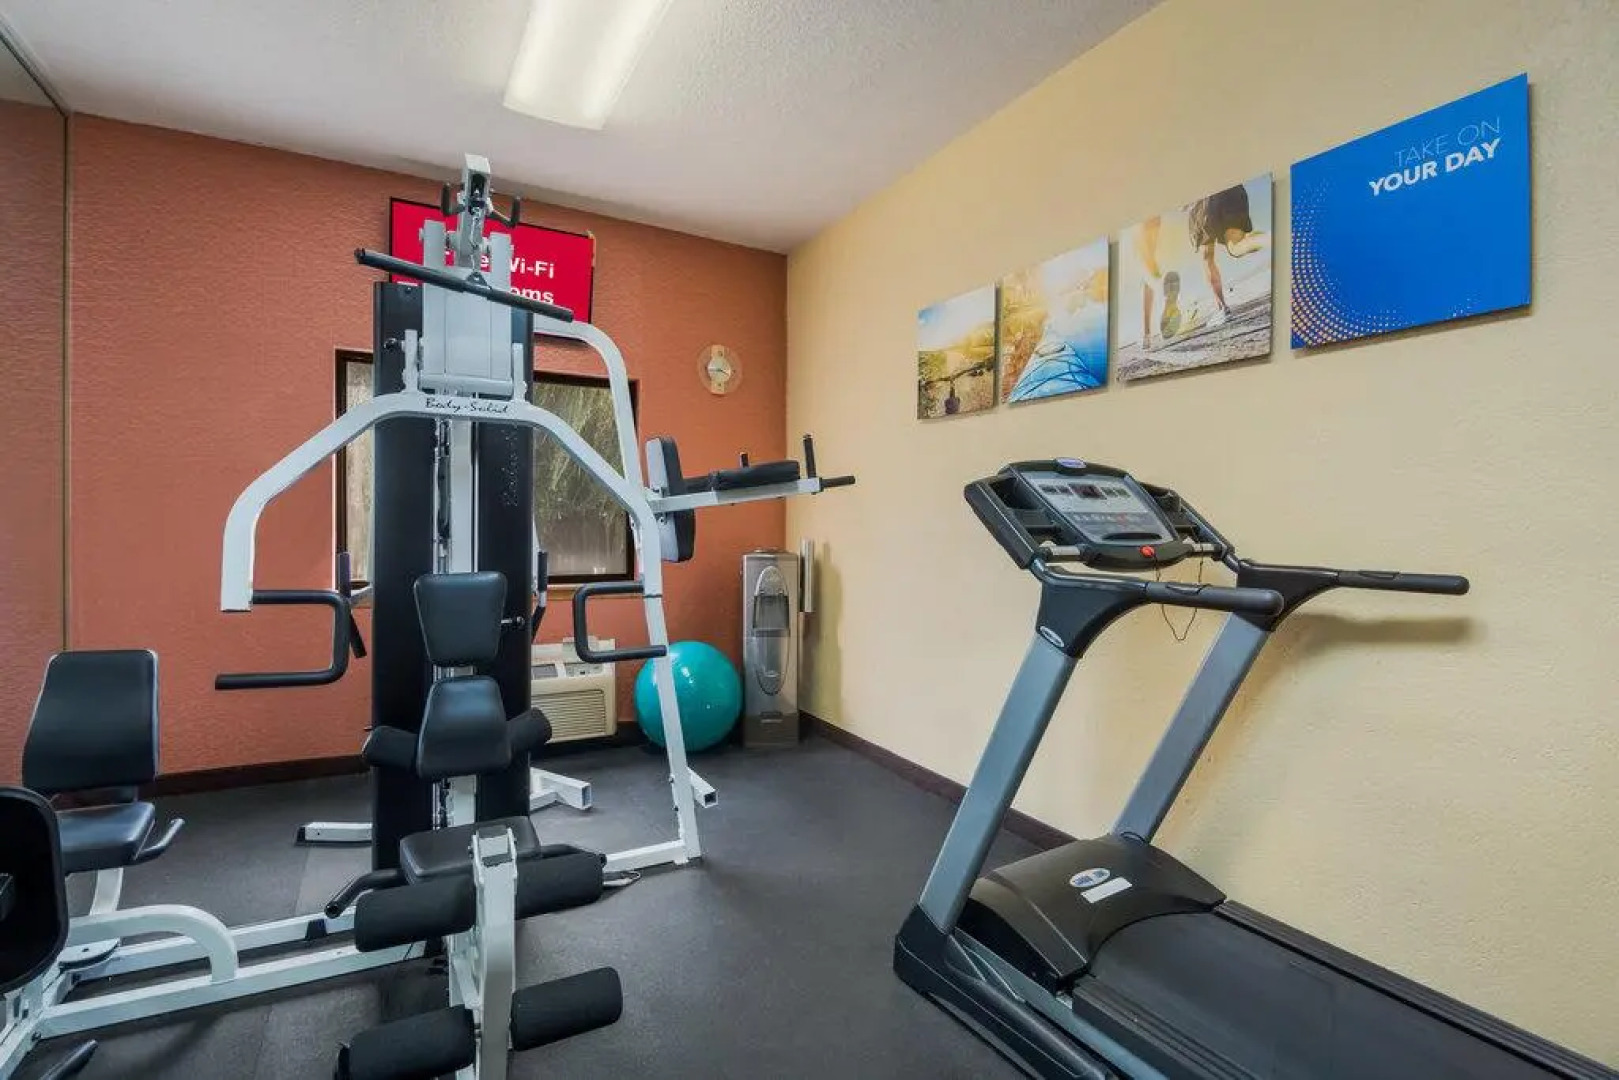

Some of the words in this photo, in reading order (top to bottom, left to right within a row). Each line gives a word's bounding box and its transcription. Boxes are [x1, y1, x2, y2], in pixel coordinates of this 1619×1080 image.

[1368, 160, 1438, 197] YOUR
[1444, 137, 1501, 173] DAY
[1394, 133, 1449, 167] TAKE
[1457, 116, 1500, 146] ON
